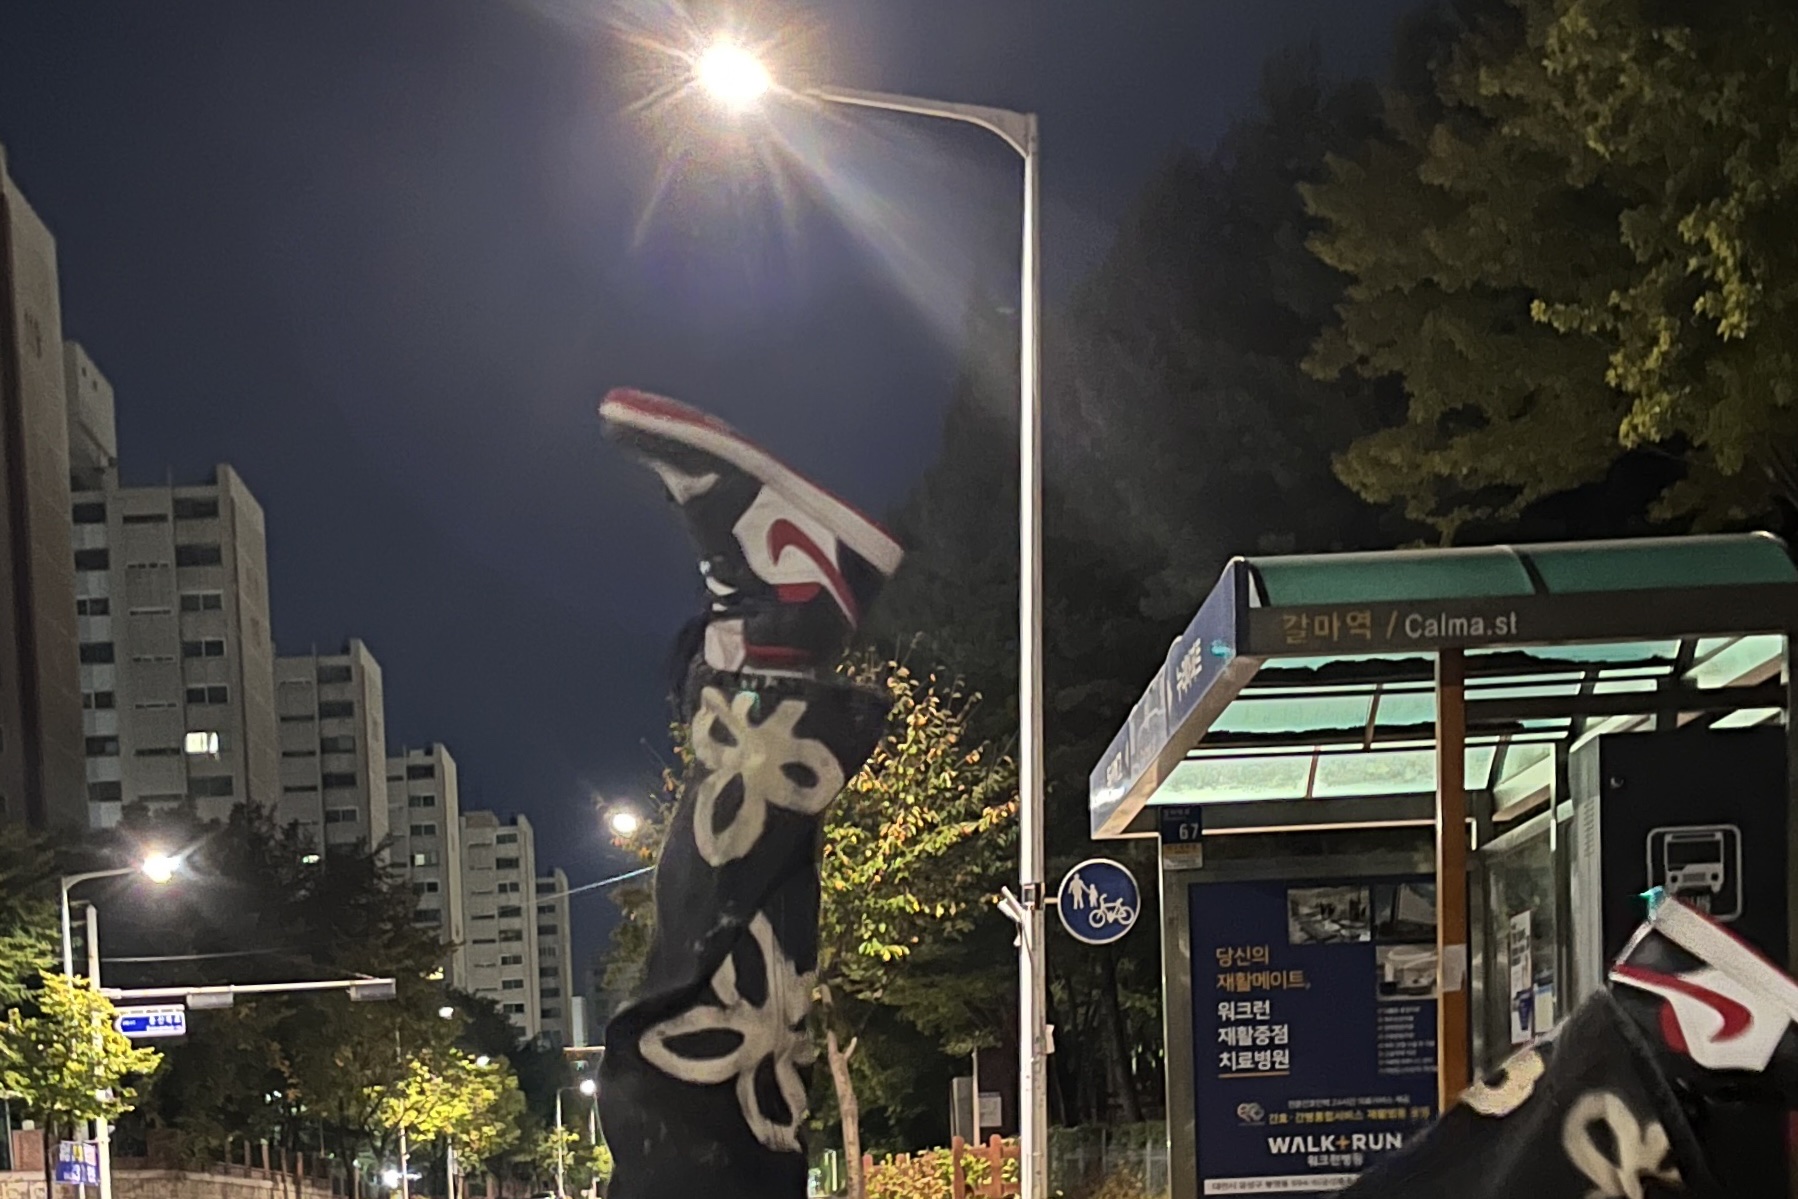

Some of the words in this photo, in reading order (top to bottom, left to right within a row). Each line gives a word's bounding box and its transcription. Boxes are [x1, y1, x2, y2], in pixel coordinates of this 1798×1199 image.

[1282, 609, 1372, 644] 갈마역
[1404, 610, 1518, 638] Calma.st
[1179, 823, 1200, 840] 67
[1216, 944, 1269, 967] 당신의
[1216, 970, 1311, 992] 재활메이트,
[1217, 1000, 1270, 1021] 워크런
[1217, 1024, 1289, 1046] 재활중점
[1219, 1048, 1290, 1071] 치료병원
[1268, 1132, 1403, 1154] WALK+RUN
